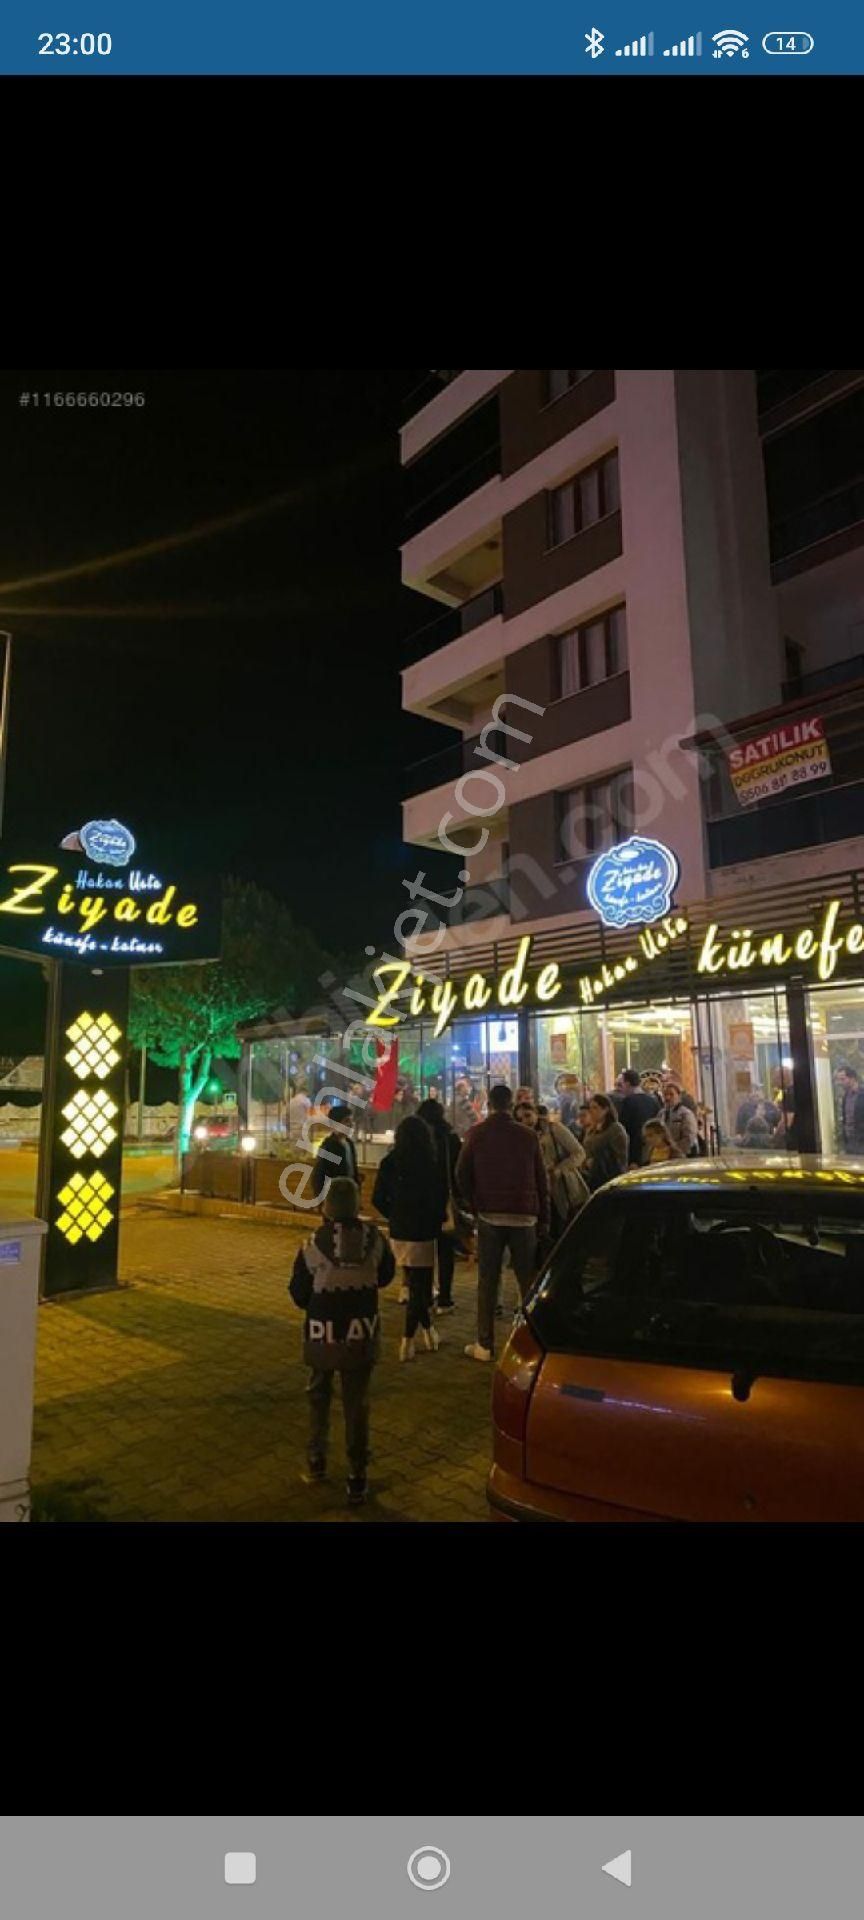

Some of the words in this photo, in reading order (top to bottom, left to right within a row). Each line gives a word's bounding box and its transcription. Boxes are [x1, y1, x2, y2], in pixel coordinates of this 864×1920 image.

[728, 717, 823, 769] SATILIK
[810, 761, 827, 774] 99
[0, 864, 199, 933] Ziyade
[600, 861, 662, 892] Ziyade
[697, 900, 864, 981] künefe
[366, 935, 562, 1039] Ziyade
